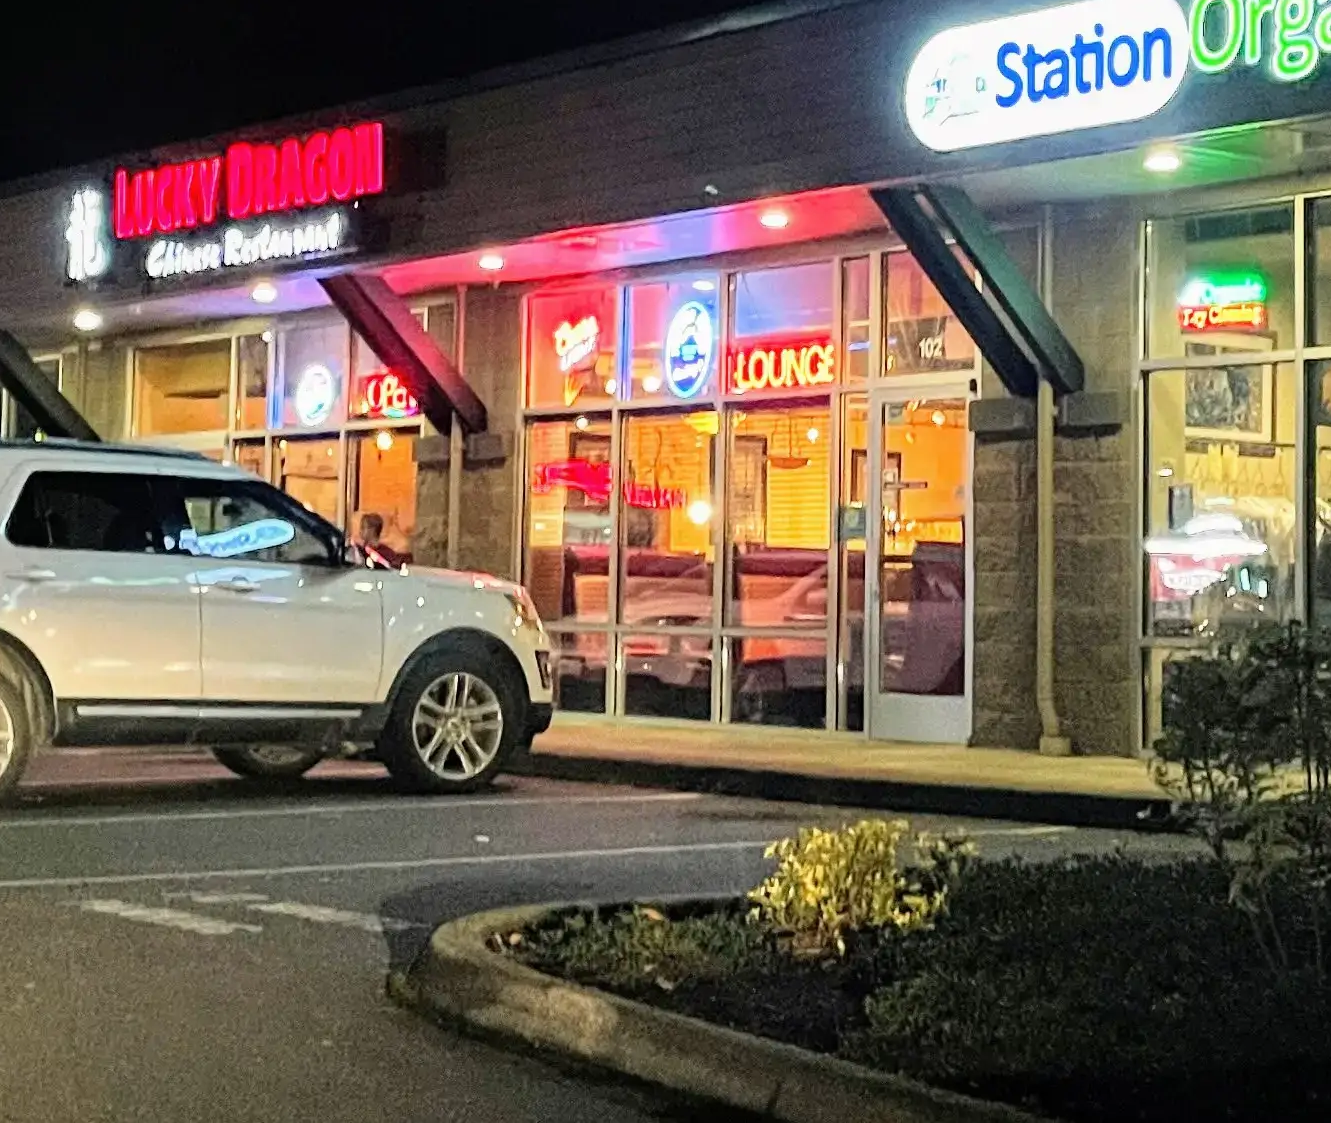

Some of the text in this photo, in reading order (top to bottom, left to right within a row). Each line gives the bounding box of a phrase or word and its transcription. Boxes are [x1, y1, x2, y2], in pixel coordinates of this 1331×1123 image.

[994, 22, 1172, 109] Station
[114, 122, 384, 239] LUCKY DRAGON
[735, 344, 835, 389] LOUNGE
[919, 337, 943, 359] 102
